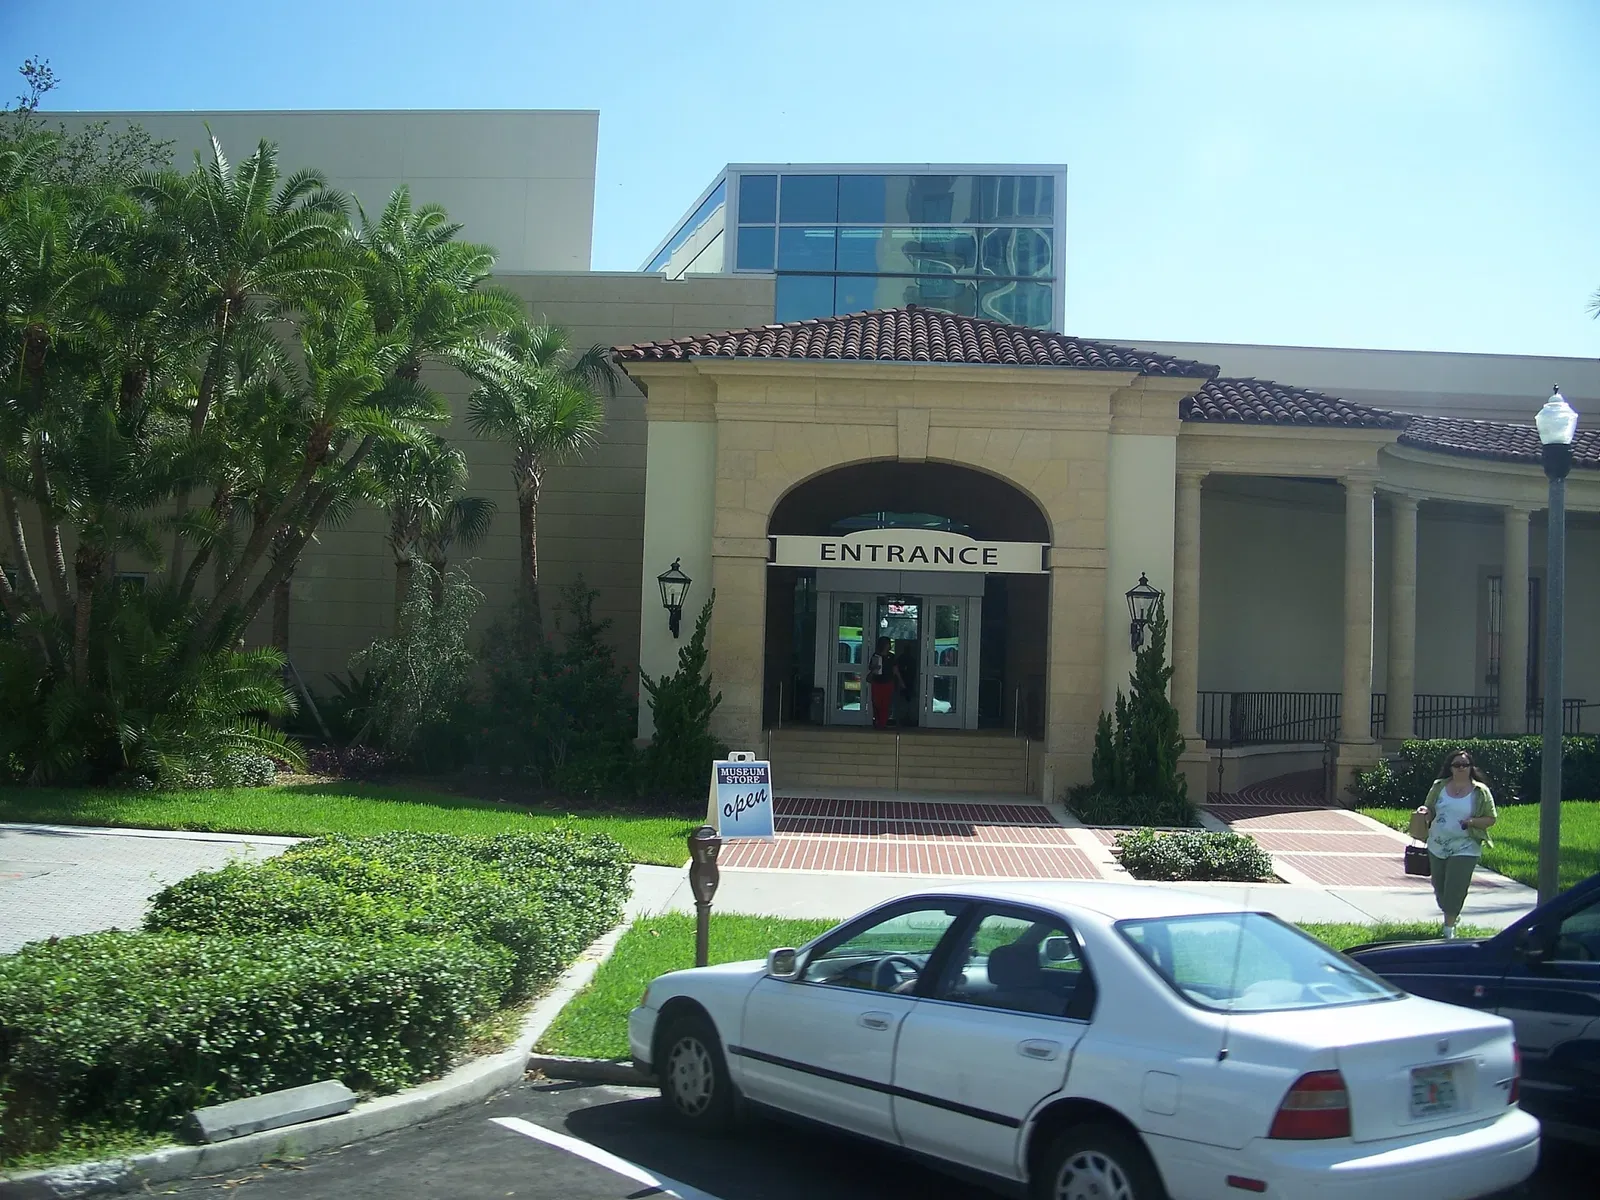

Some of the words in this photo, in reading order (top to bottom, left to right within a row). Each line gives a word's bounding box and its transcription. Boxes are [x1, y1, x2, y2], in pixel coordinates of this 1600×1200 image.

[820, 543, 998, 566] ENTRANCE
[721, 768, 765, 776] MUSEUM
[727, 776, 760, 784] STORE
[724, 788, 767, 821] open
